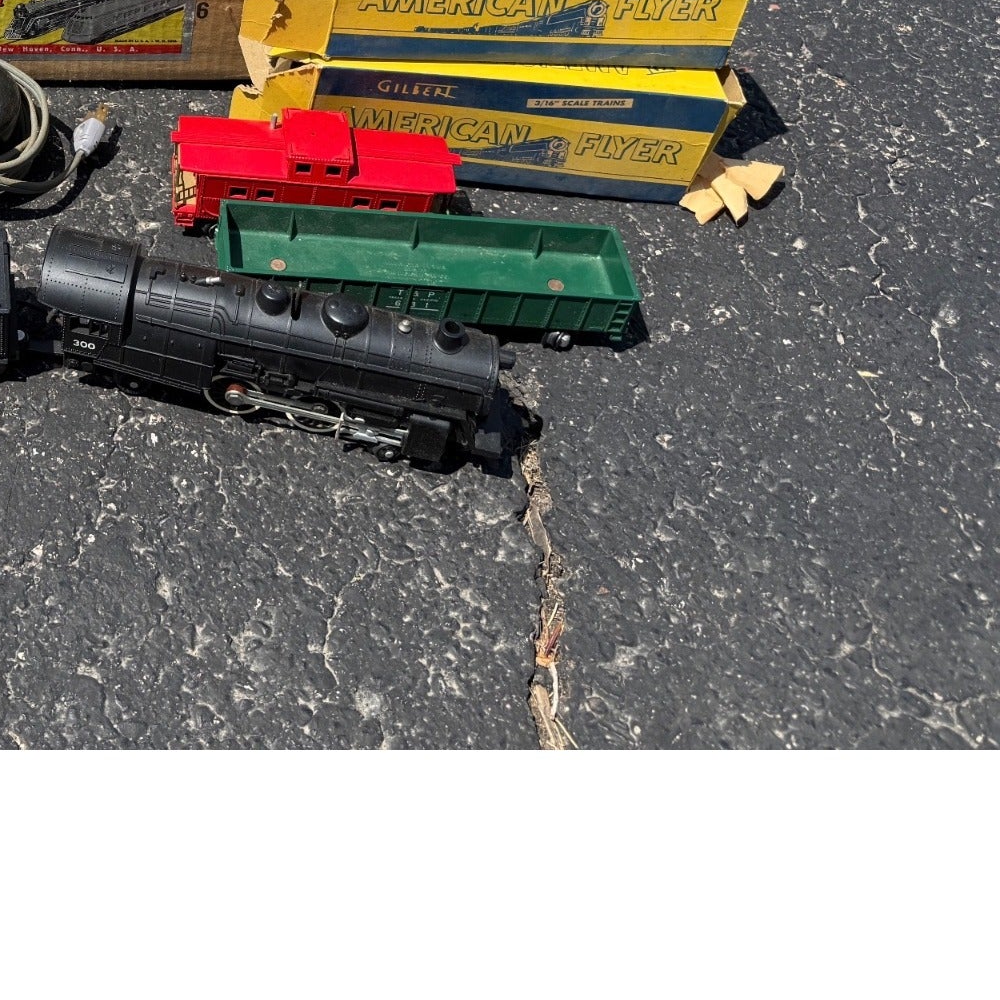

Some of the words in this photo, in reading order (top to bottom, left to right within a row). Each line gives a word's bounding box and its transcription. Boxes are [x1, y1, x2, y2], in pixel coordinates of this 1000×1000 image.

[196, 2, 210, 19] 6
[377, 79, 459, 99] GILBERT
[561, 99, 590, 107] SCALE
[592, 99, 626, 107] TRAINS
[339, 106, 531, 145] AMERICAN
[574, 131, 683, 165] FLYER
[72, 339, 96, 350] 300
